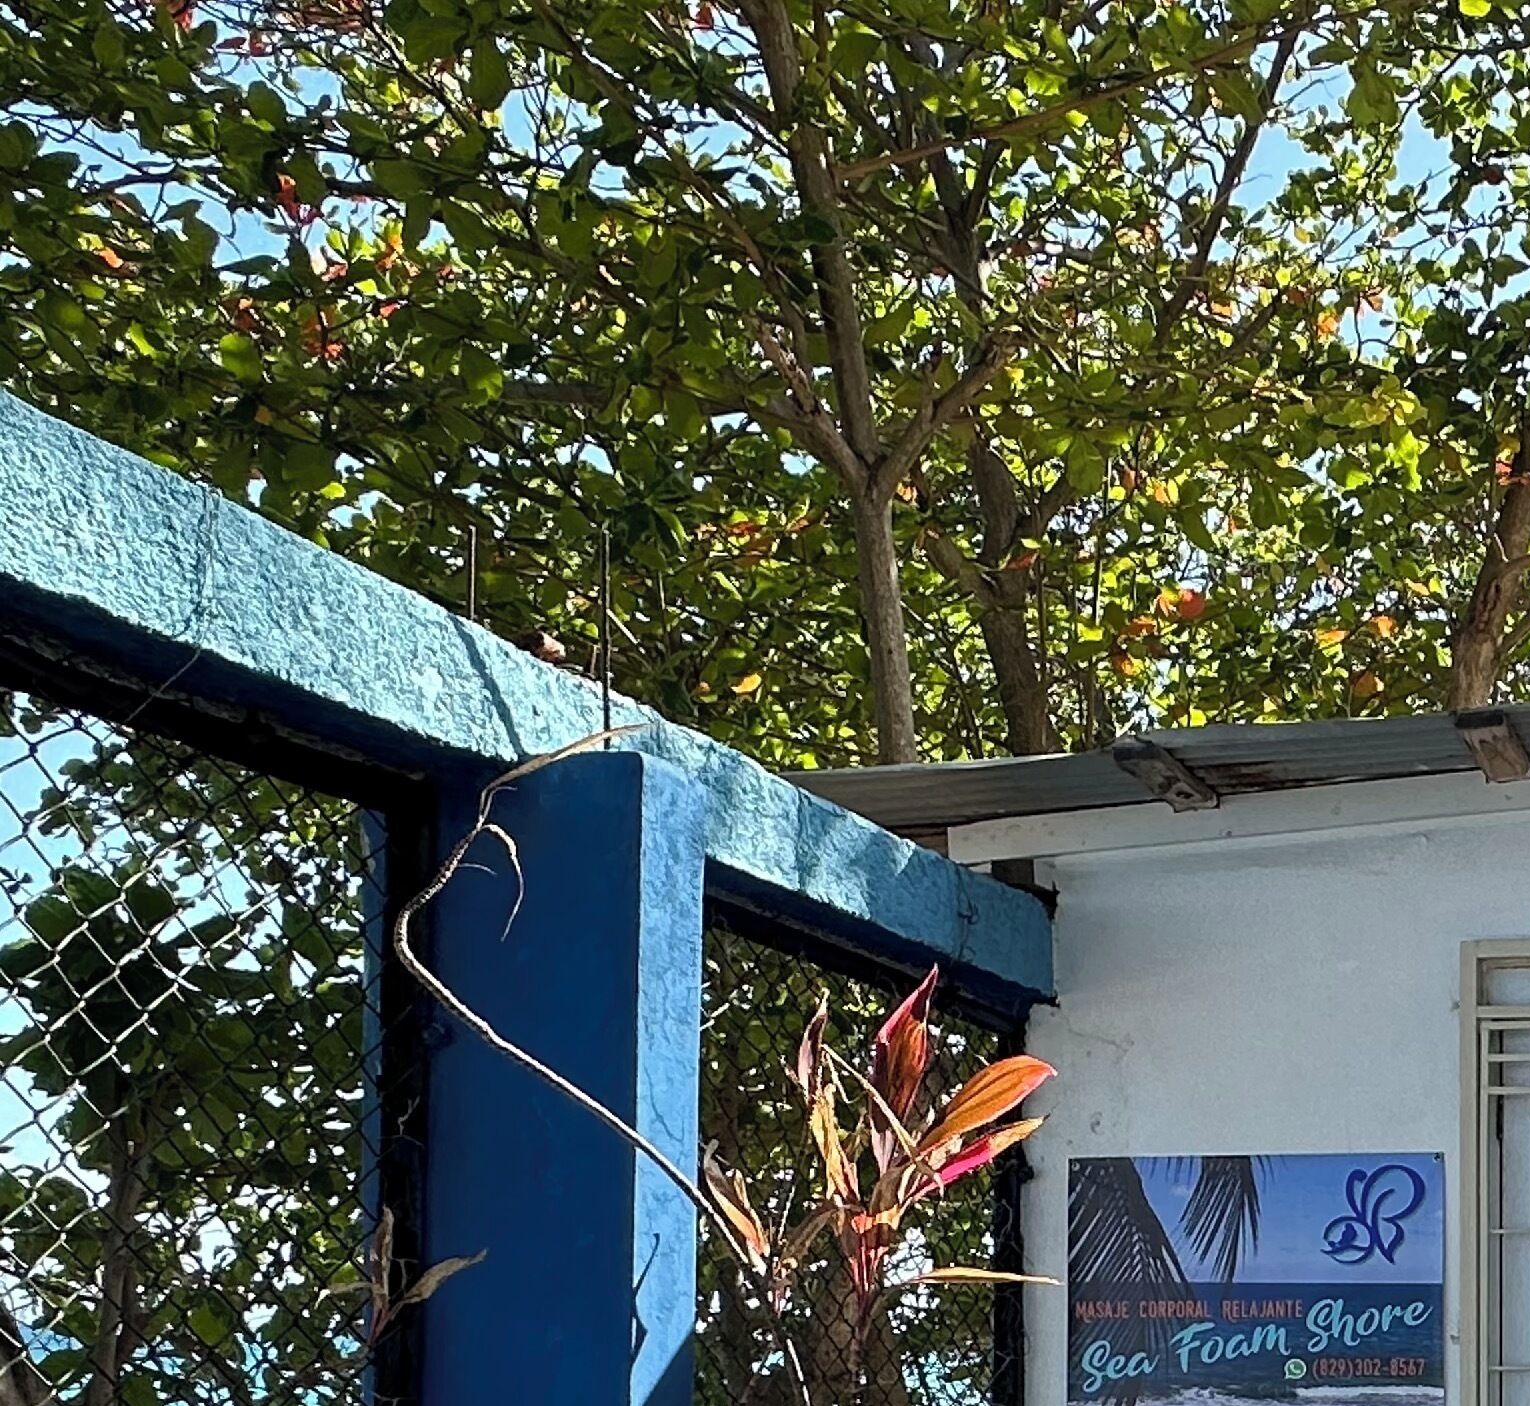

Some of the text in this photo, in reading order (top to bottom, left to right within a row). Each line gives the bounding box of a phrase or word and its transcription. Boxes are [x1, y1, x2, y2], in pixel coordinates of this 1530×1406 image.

[1075, 1299, 1303, 1324] MASAJE CORPORAL RELAJANTE
[1081, 1299, 1433, 1393] Sea Foam Shore
